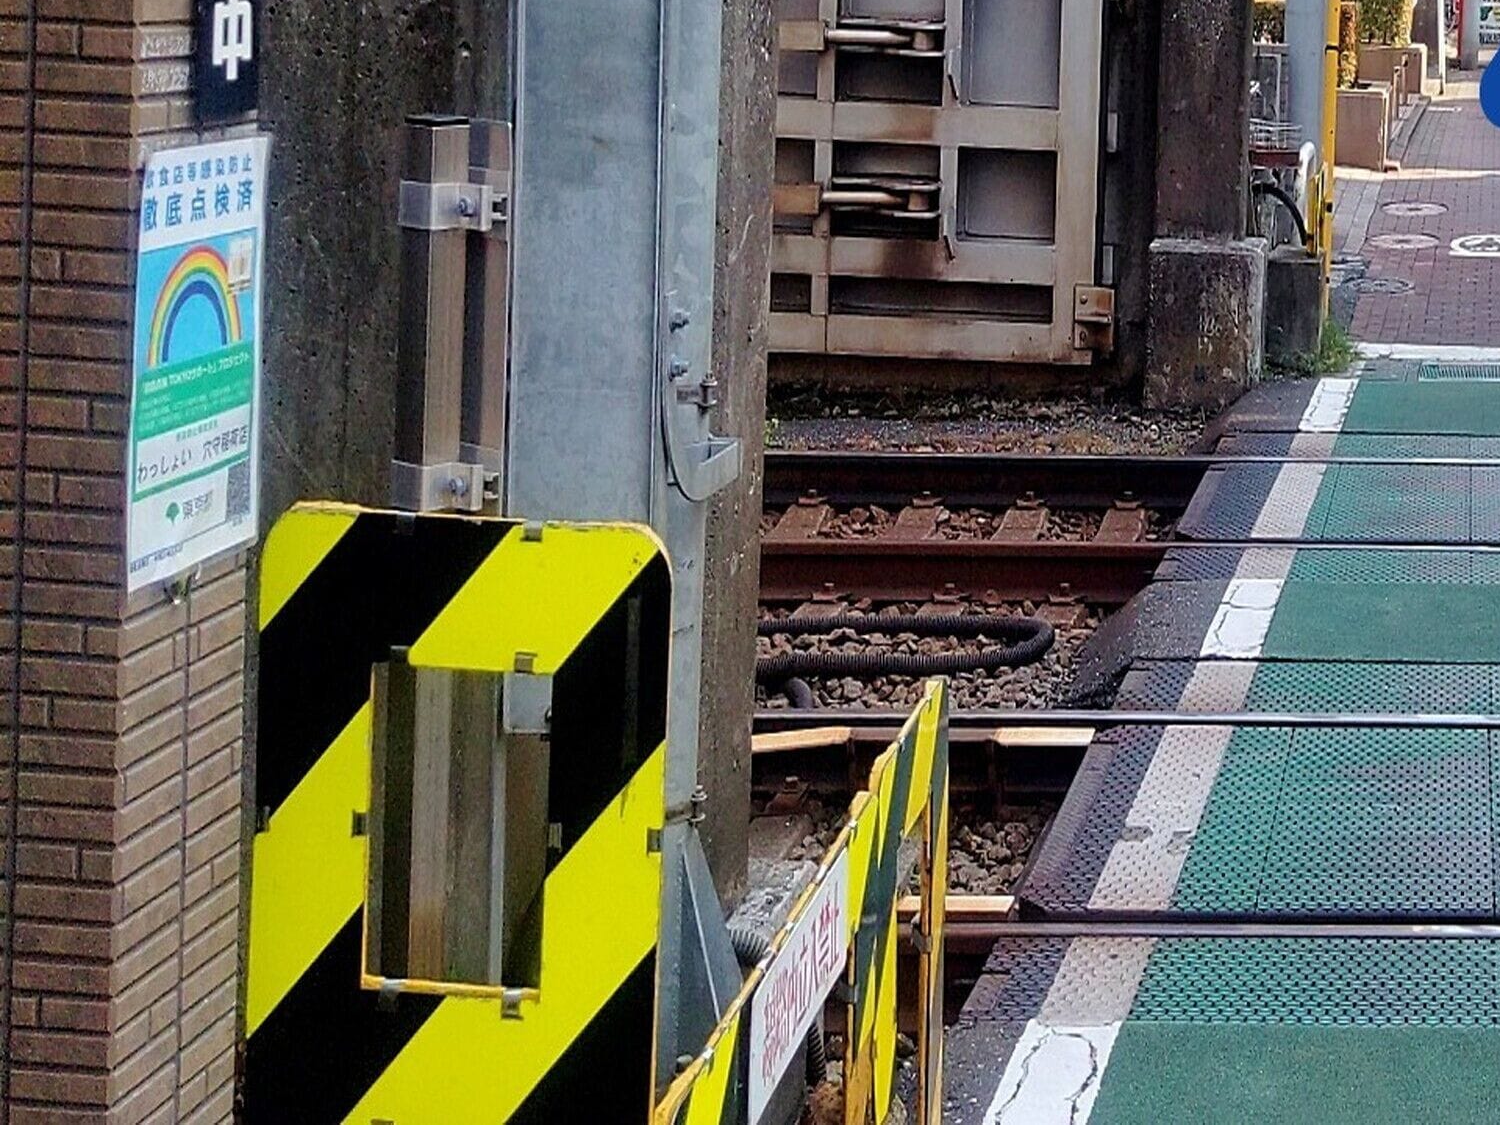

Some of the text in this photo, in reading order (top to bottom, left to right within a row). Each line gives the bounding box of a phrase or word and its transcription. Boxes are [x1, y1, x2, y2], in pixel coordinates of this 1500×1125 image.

[137, 449, 192, 483] わっしょい
